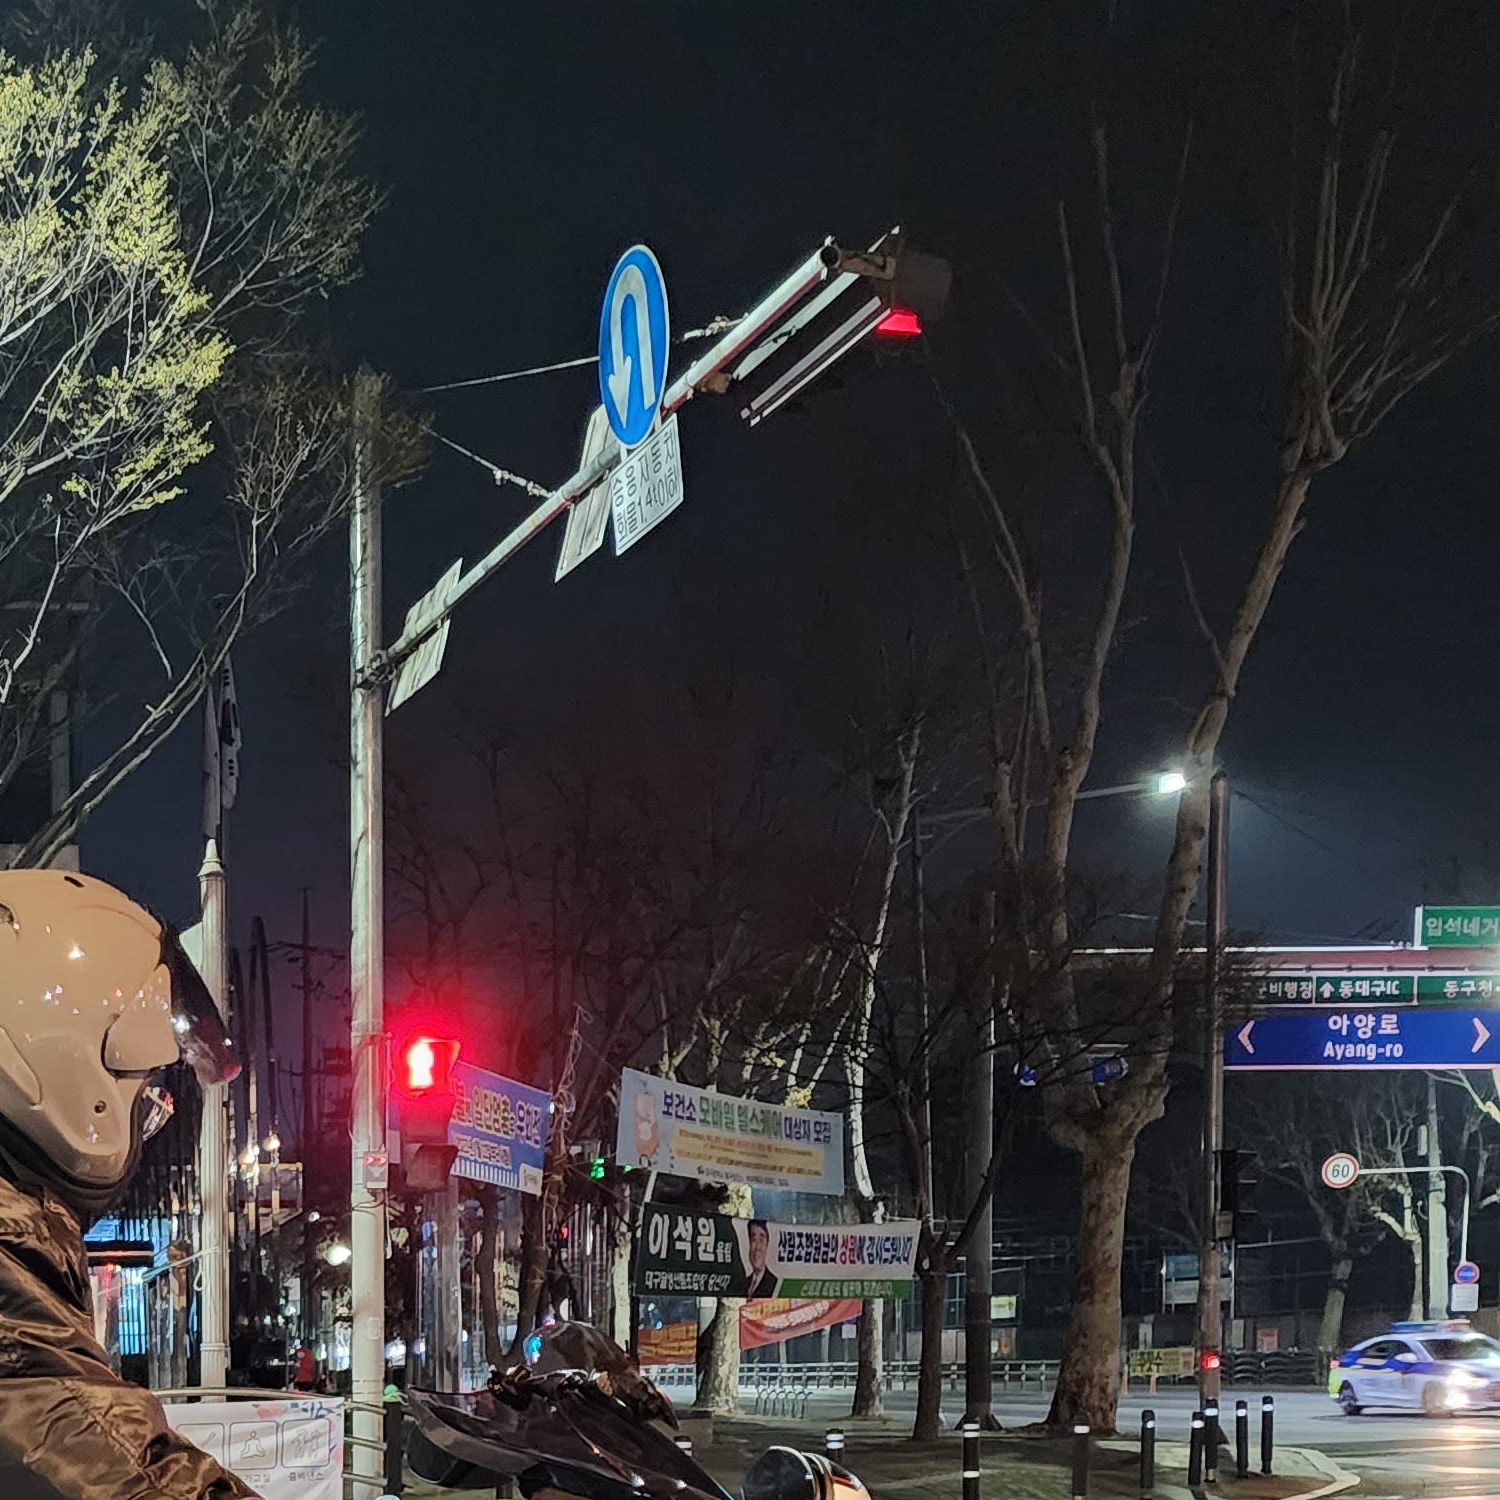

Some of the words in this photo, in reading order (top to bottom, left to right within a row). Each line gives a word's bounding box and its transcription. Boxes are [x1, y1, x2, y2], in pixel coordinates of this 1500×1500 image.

[1338, 980, 1400, 999] 동대구IC
[1328, 1014, 1401, 1039] 아양로
[1323, 1041, 1404, 1060] Ayang-ro
[662, 1091, 697, 1121] 보건소
[698, 1095, 736, 1132] 모바일
[783, 1116, 811, 1143] 대상자
[813, 1120, 832, 1143] 모집
[1331, 1163, 1350, 1179] 60
[648, 1213, 716, 1262] 이석원
